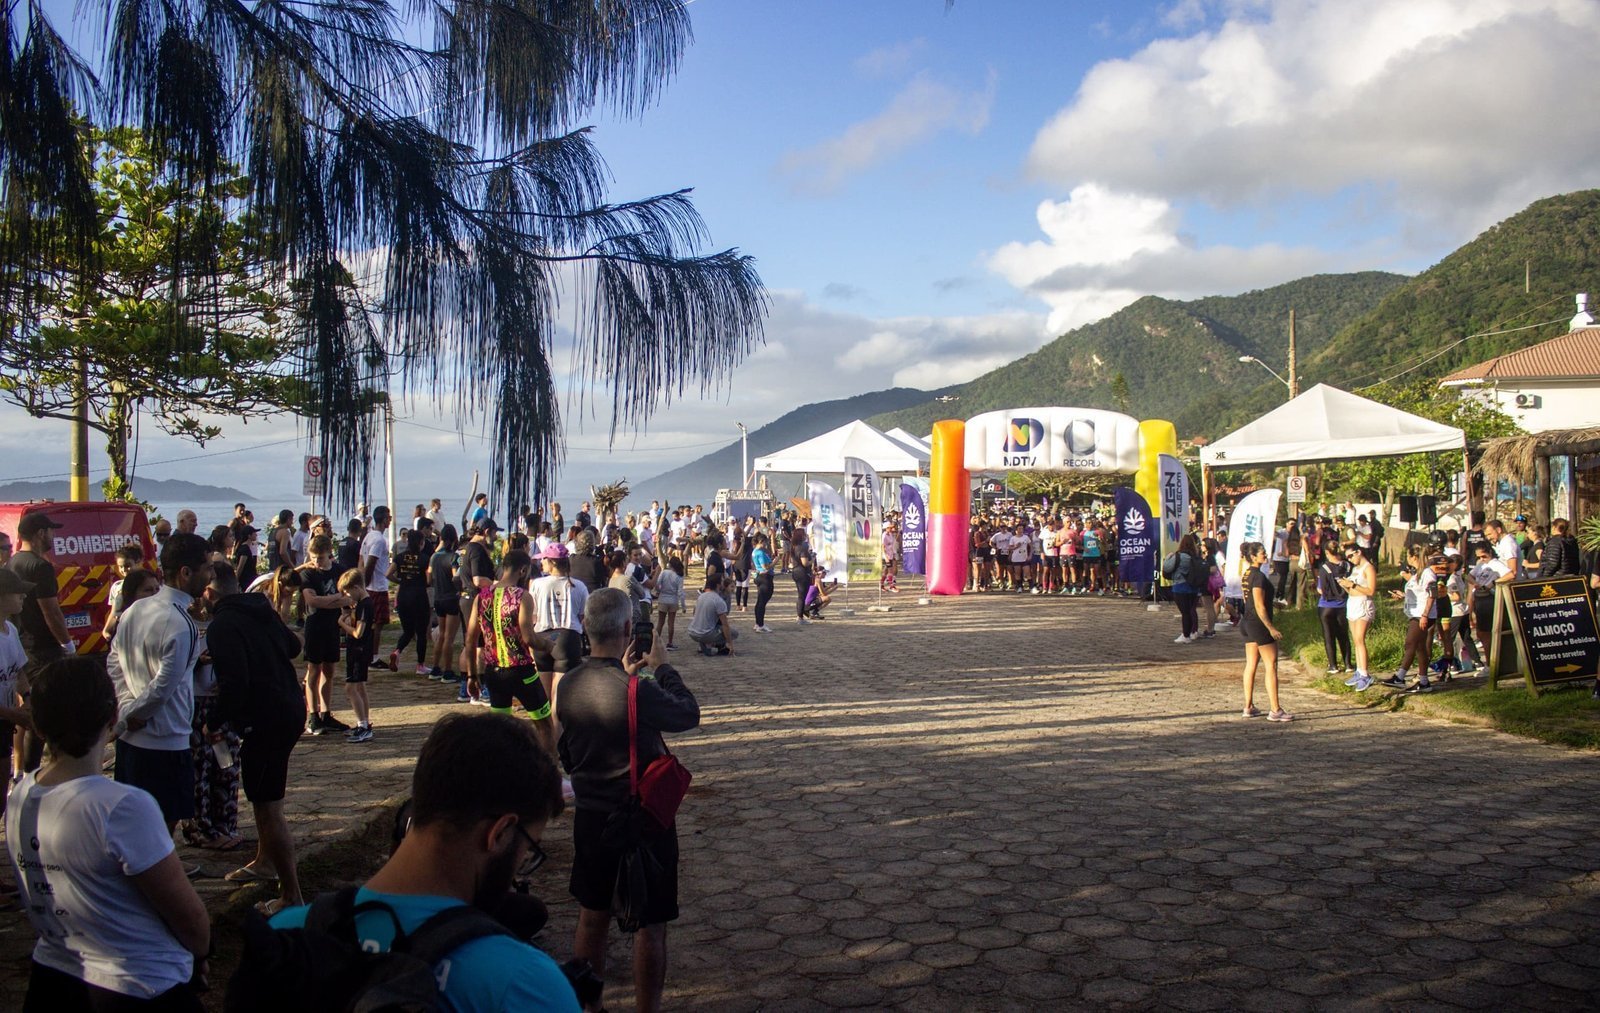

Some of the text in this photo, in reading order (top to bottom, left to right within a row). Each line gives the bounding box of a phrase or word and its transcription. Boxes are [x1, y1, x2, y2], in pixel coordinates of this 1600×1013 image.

[1004, 456, 1037, 467] NDTV
[1063, 459, 1101, 467] RECORD
[851, 473, 866, 518] ZEN
[1164, 471, 1177, 519] ZEN
[902, 531, 924, 540] OCEAN
[53, 534, 140, 556] BOMBEIROS
[902, 539, 920, 548] DROP
[1120, 538, 1151, 546] OCEAN
[1120, 546, 1146, 555] DROP
[1533, 623, 1575, 636] ALMOÇO
[1536, 640, 1563, 649] Lanches
[1540, 653, 1557, 661] Doces
[1562, 650, 1586, 658] sorvetes
